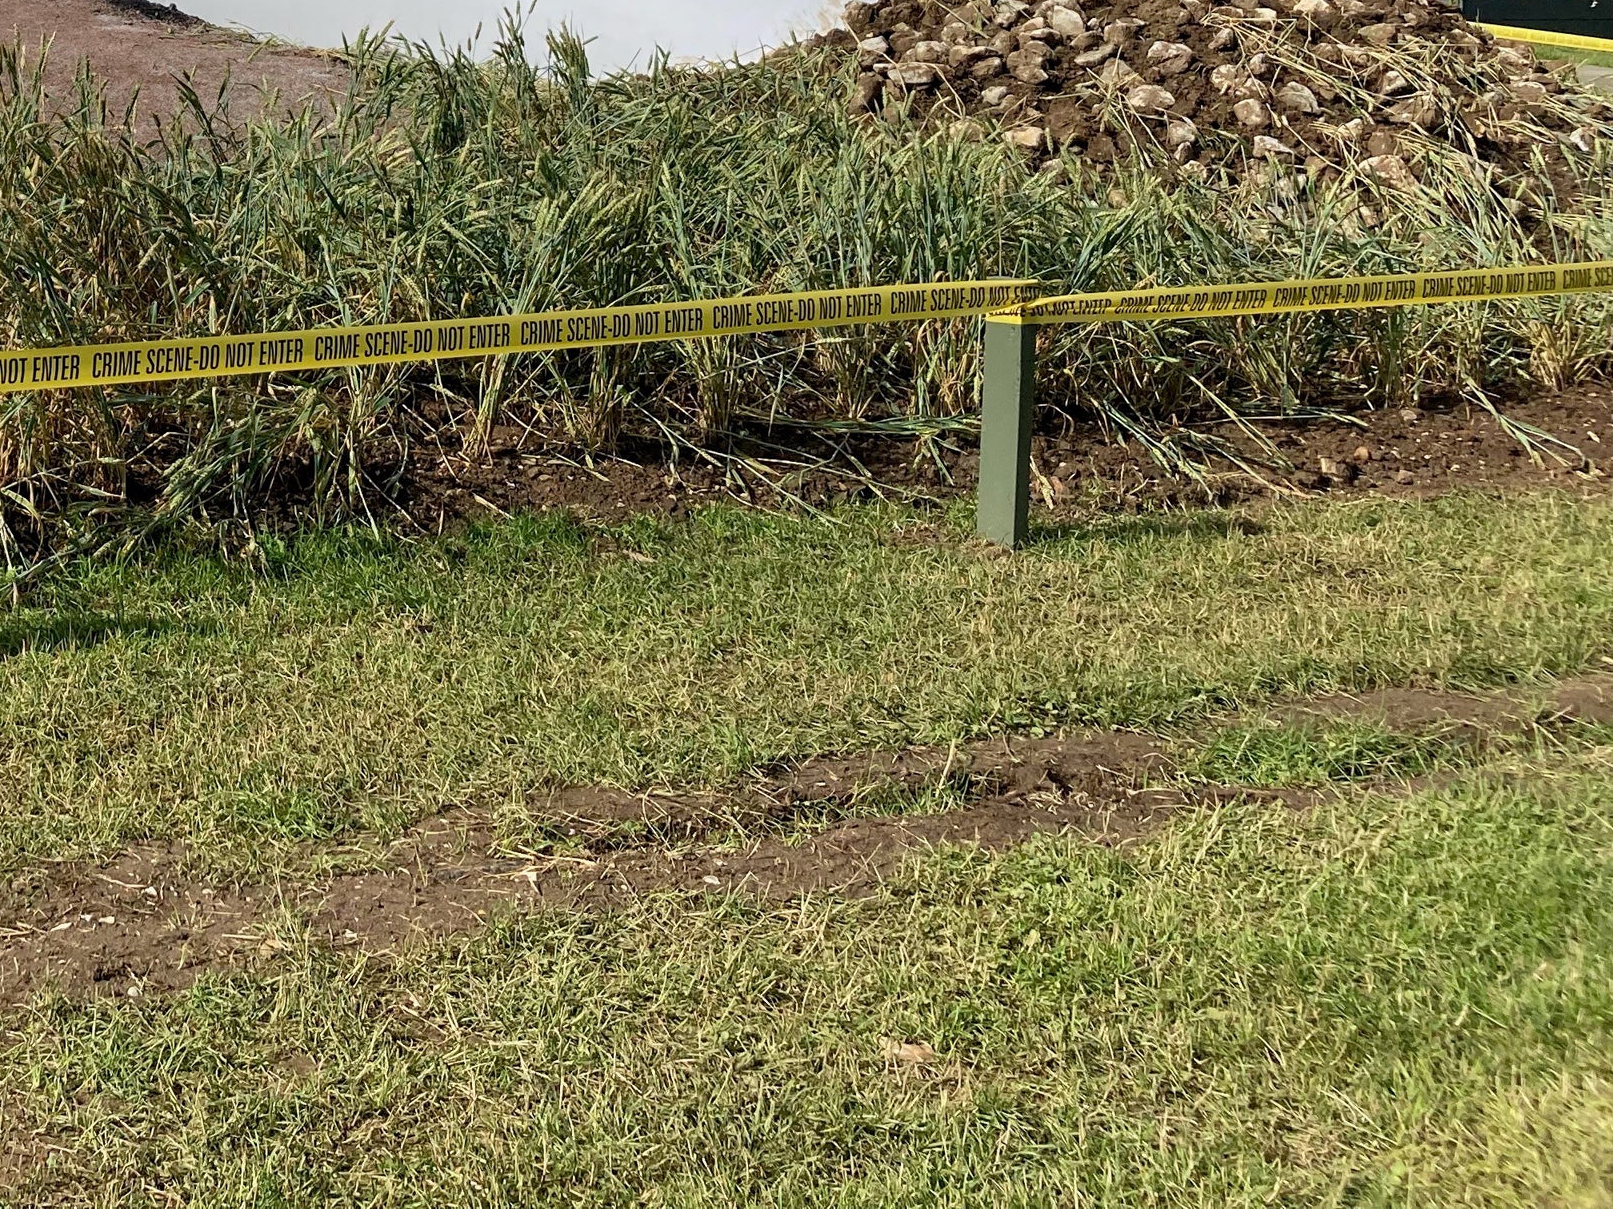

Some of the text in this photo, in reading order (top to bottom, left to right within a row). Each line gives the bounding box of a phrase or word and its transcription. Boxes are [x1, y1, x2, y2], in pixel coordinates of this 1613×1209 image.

[1073, 298, 1112, 315] ENTER
[1115, 296, 1154, 315] CRIME
[1153, 292, 1207, 313] SCENE-DO
[1208, 291, 1233, 311] NOT
[1233, 289, 1267, 310] ENTER
[1272, 286, 1308, 308] CRIME
[1309, 283, 1360, 306] SCENE-DO
[1362, 282, 1385, 302] NOT
[1386, 280, 1416, 300] ENTER
[1422, 277, 1454, 298] CRIME
[1455, 274, 1503, 296] SCENE-DO
[1505, 273, 1526, 294] NOT
[1527, 271, 1556, 292] ENTER
[1563, 269, 1591, 290] CRIME
[32, 354, 80, 382] ENTER
[92, 350, 142, 379] CRIME
[146, 344, 220, 374] SCENE-DO
[225, 341, 256, 369] NOT
[259, 338, 303, 366] ENTER
[314, 333, 360, 361] CRIME
[364, 328, 432, 357] SCENE-DO
[437, 325, 465, 352] NOT
[469, 322, 510, 349] ENTER
[520, 319, 563, 345] CRIME
[566, 313, 631, 341] SCENE-DO
[635, 311, 660, 336] NOT
[664, 307, 703, 334] ENTER
[712, 302, 752, 329] CRIME
[756, 297, 815, 326] SCENE-DO
[819, 295, 842, 320] NOT
[846, 293, 882, 319] ENTER
[890, 290, 927, 315] CRIME
[930, 286, 985, 311] SCENE-DO
[987, 286, 1010, 307] NOT
